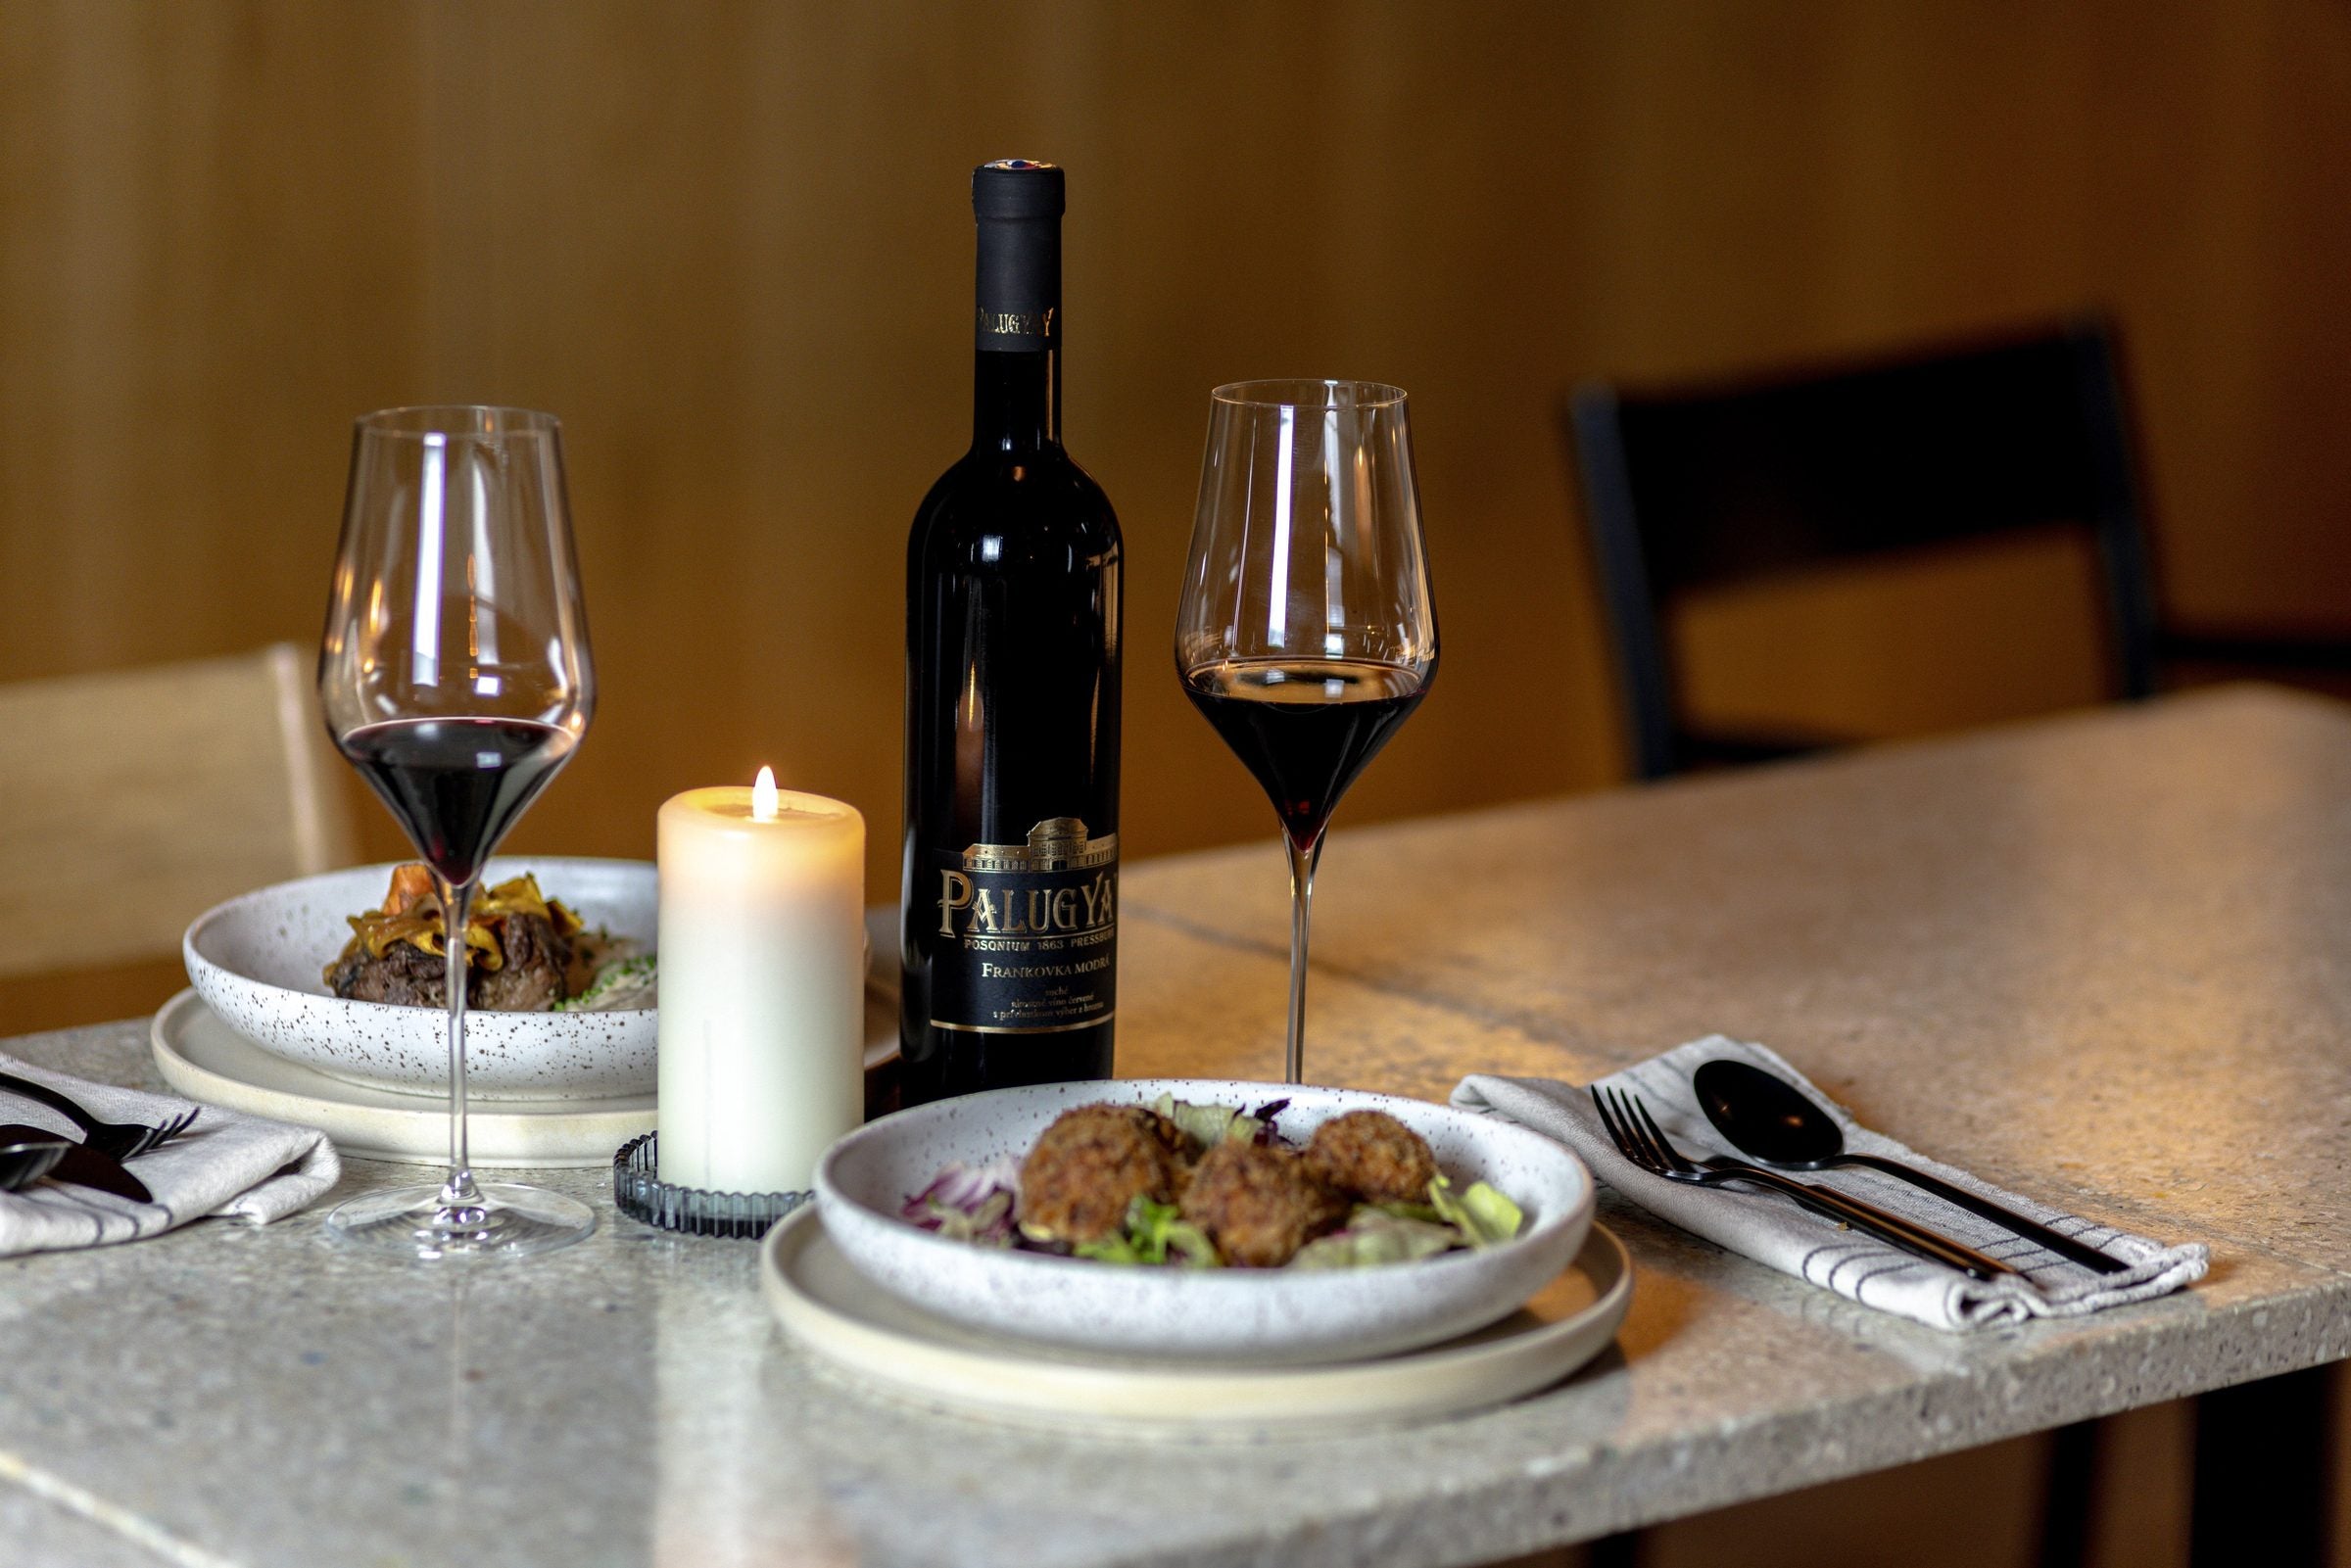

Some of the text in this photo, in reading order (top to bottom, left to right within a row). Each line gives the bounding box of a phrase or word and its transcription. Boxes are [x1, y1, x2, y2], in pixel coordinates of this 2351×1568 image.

[936, 869, 1117, 938] PALUGYA
[964, 939, 1030, 951] POSONIUM
[1037, 940, 1065, 950] 1863
[982, 963, 1072, 978] FRANKOVKA
